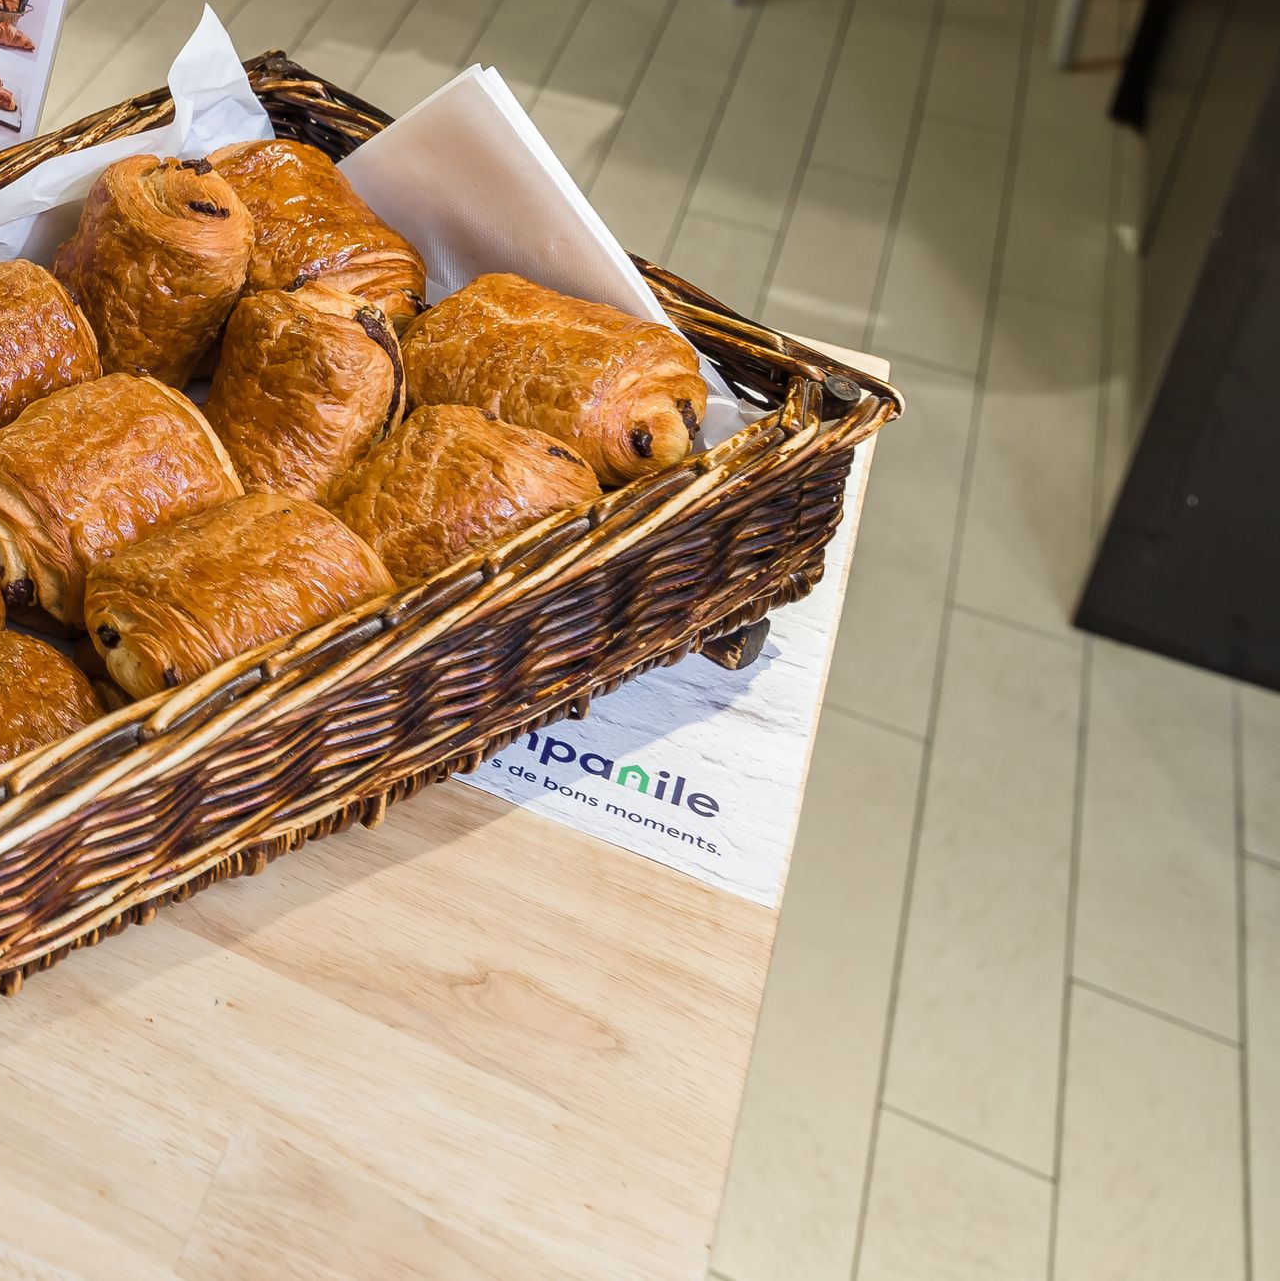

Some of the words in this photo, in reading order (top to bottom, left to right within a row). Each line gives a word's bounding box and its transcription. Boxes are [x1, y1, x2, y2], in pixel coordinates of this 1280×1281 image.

[508, 766, 537, 783] de
[543, 777, 599, 807] bons
[605, 803, 722, 857] moments.
[527, 731, 720, 818] panile
